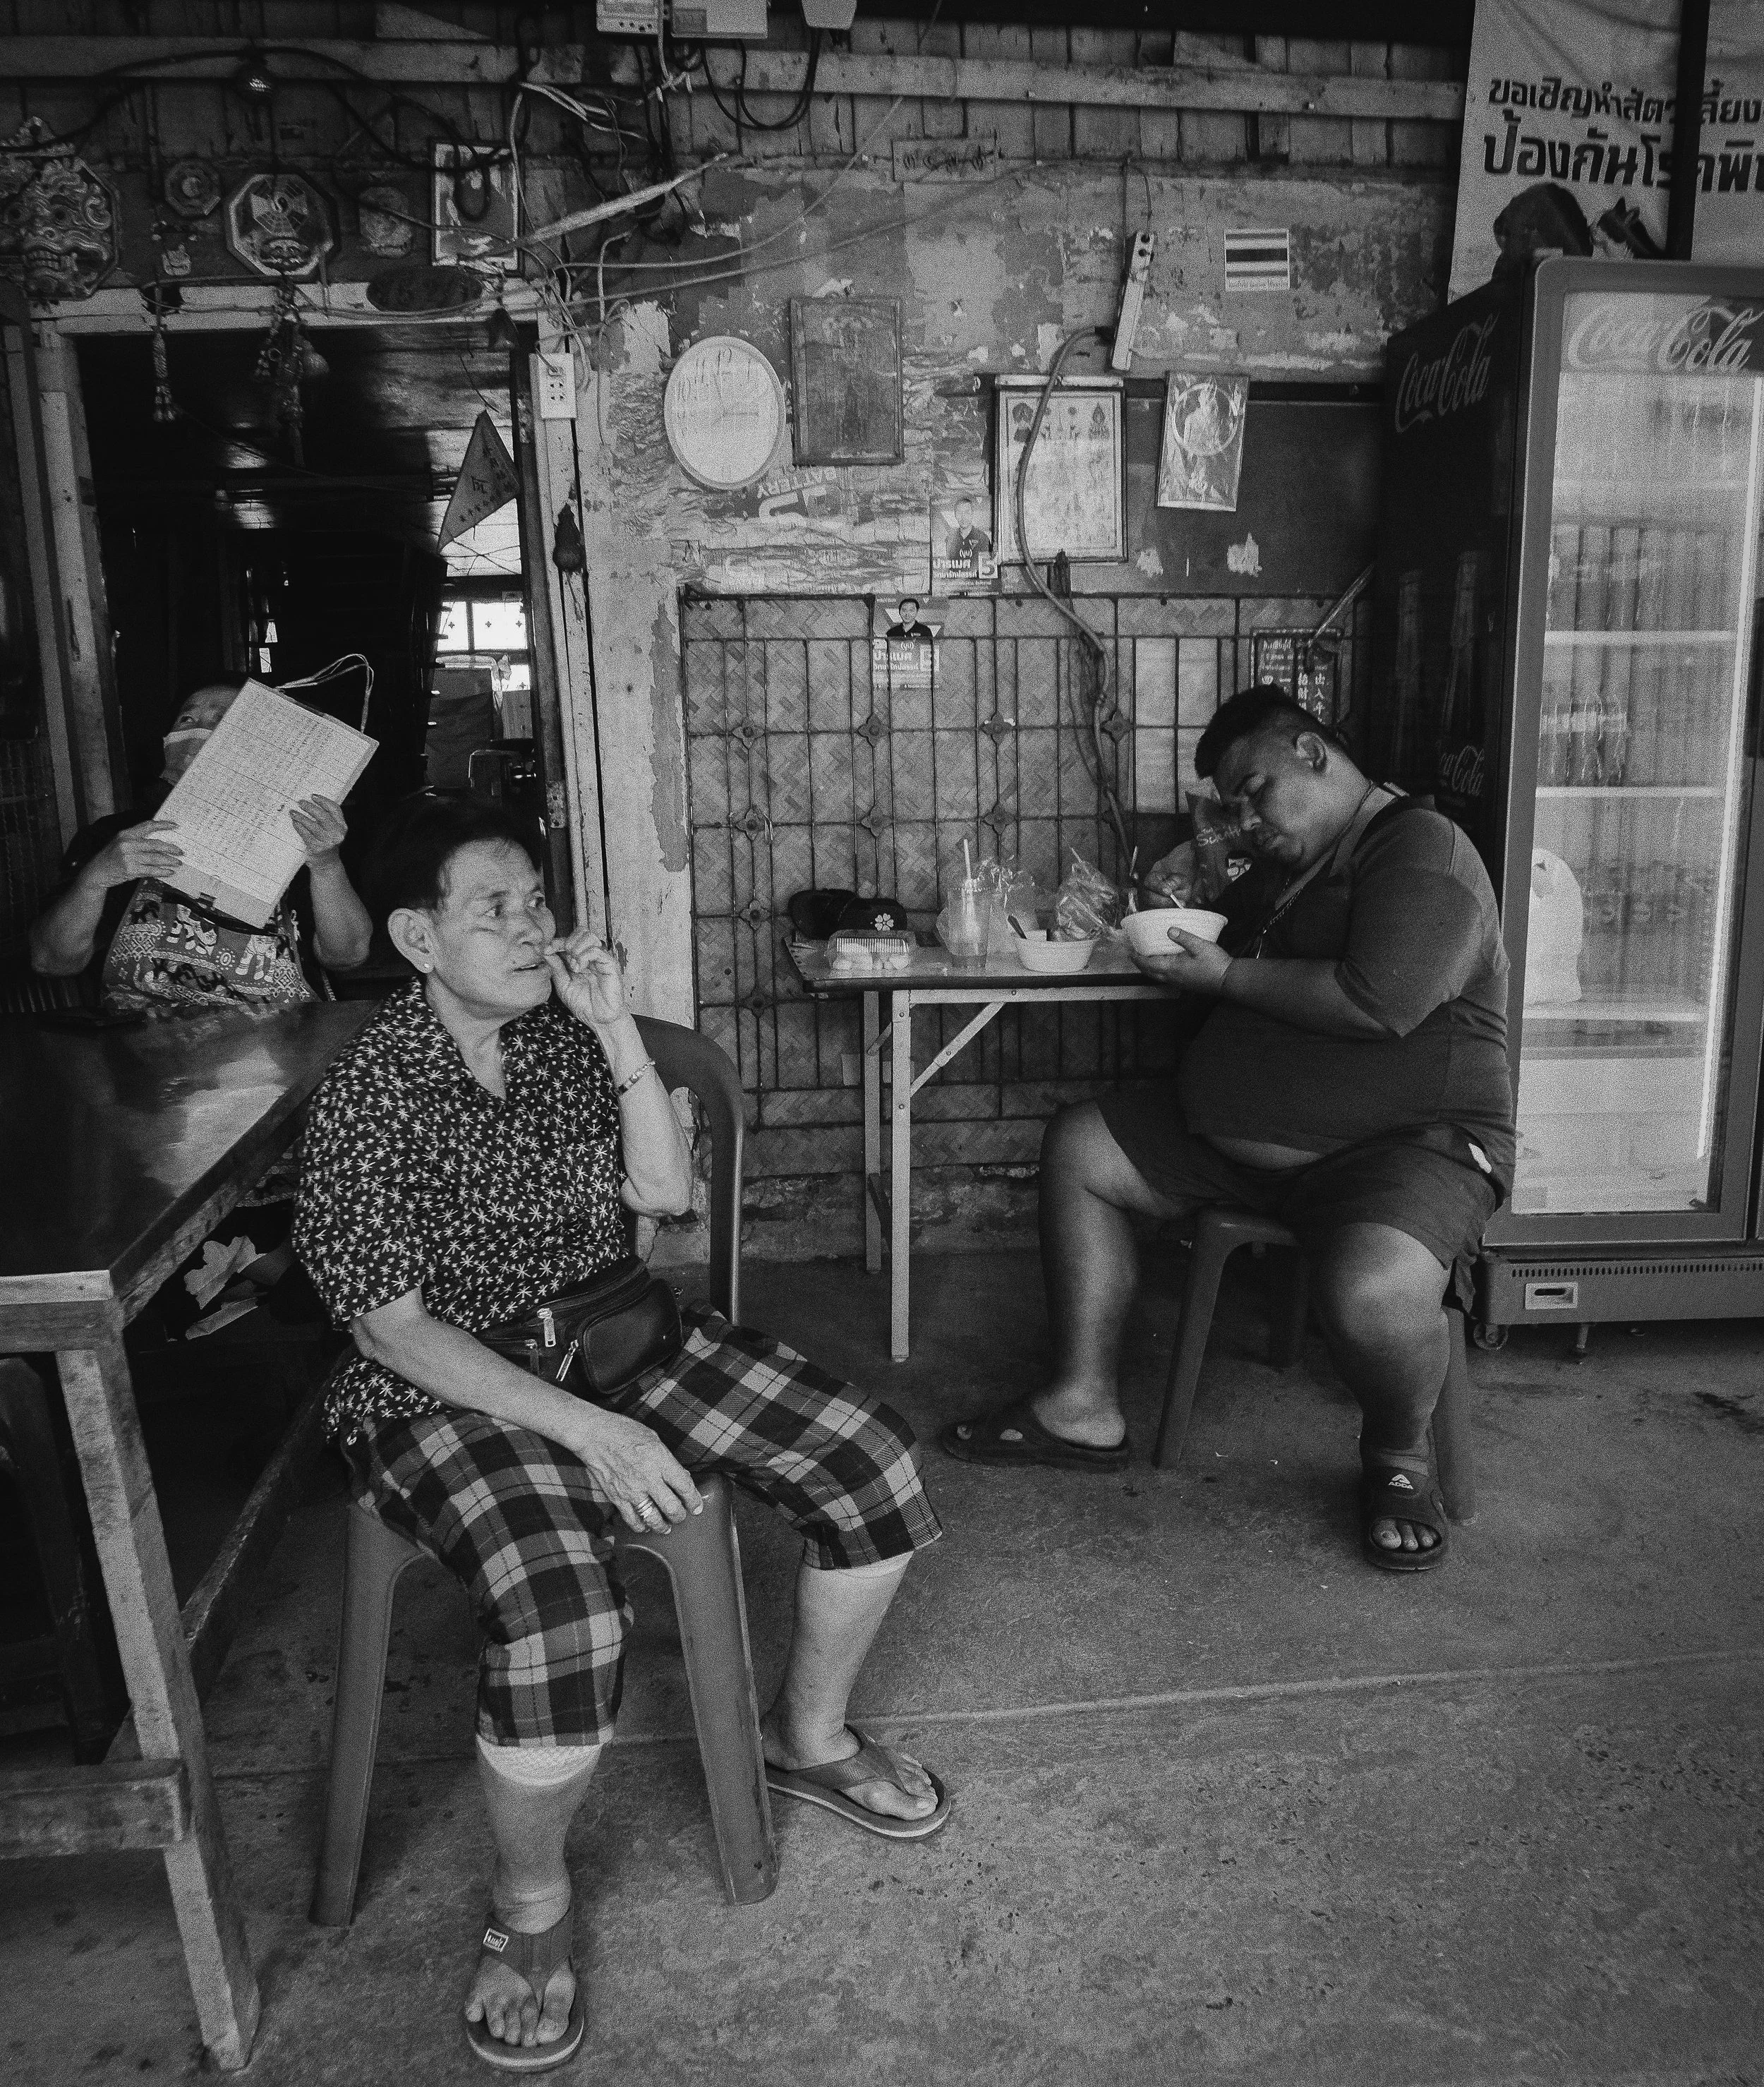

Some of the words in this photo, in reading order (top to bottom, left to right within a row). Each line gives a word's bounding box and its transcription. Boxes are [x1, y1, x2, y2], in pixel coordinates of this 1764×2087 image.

[1394, 311, 1501, 434] Coca-Cola
[1568, 303, 1764, 373] Coca-Cola
[756, 466, 837, 498] BATTERY
